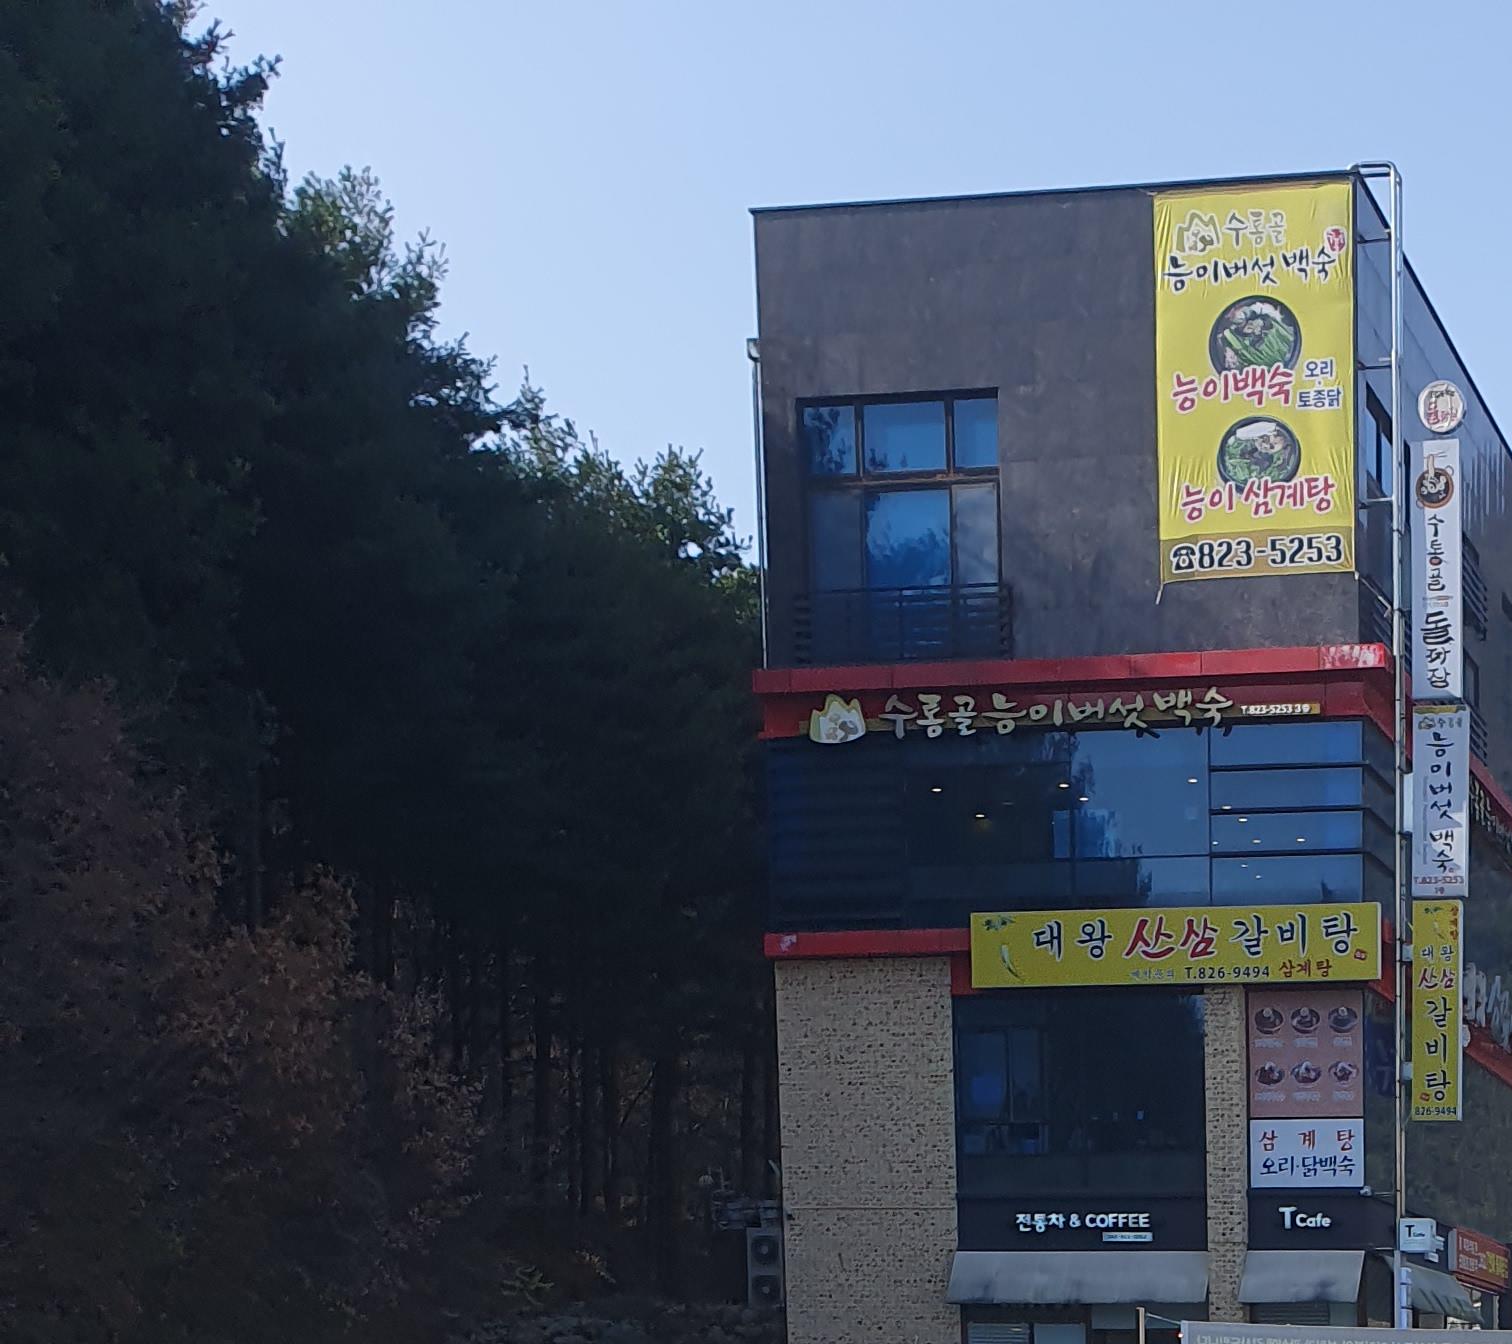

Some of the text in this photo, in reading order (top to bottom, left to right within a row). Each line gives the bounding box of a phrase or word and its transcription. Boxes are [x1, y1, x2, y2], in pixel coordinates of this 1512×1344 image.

[1222, 209, 1288, 247] 수통골
[1304, 359, 1335, 379] 오리
[1172, 365, 1295, 414] 능이백숙
[1296, 388, 1342, 409] 토종닭
[1197, 536, 1343, 570] 823-5253
[1184, 965, 1270, 979] T.826-9494
[1278, 958, 1333, 978] 삼계탕
[1414, 1106, 1457, 1117] 826-9494
[1015, 1212, 1151, 1233] 전통차 & COFFEE
